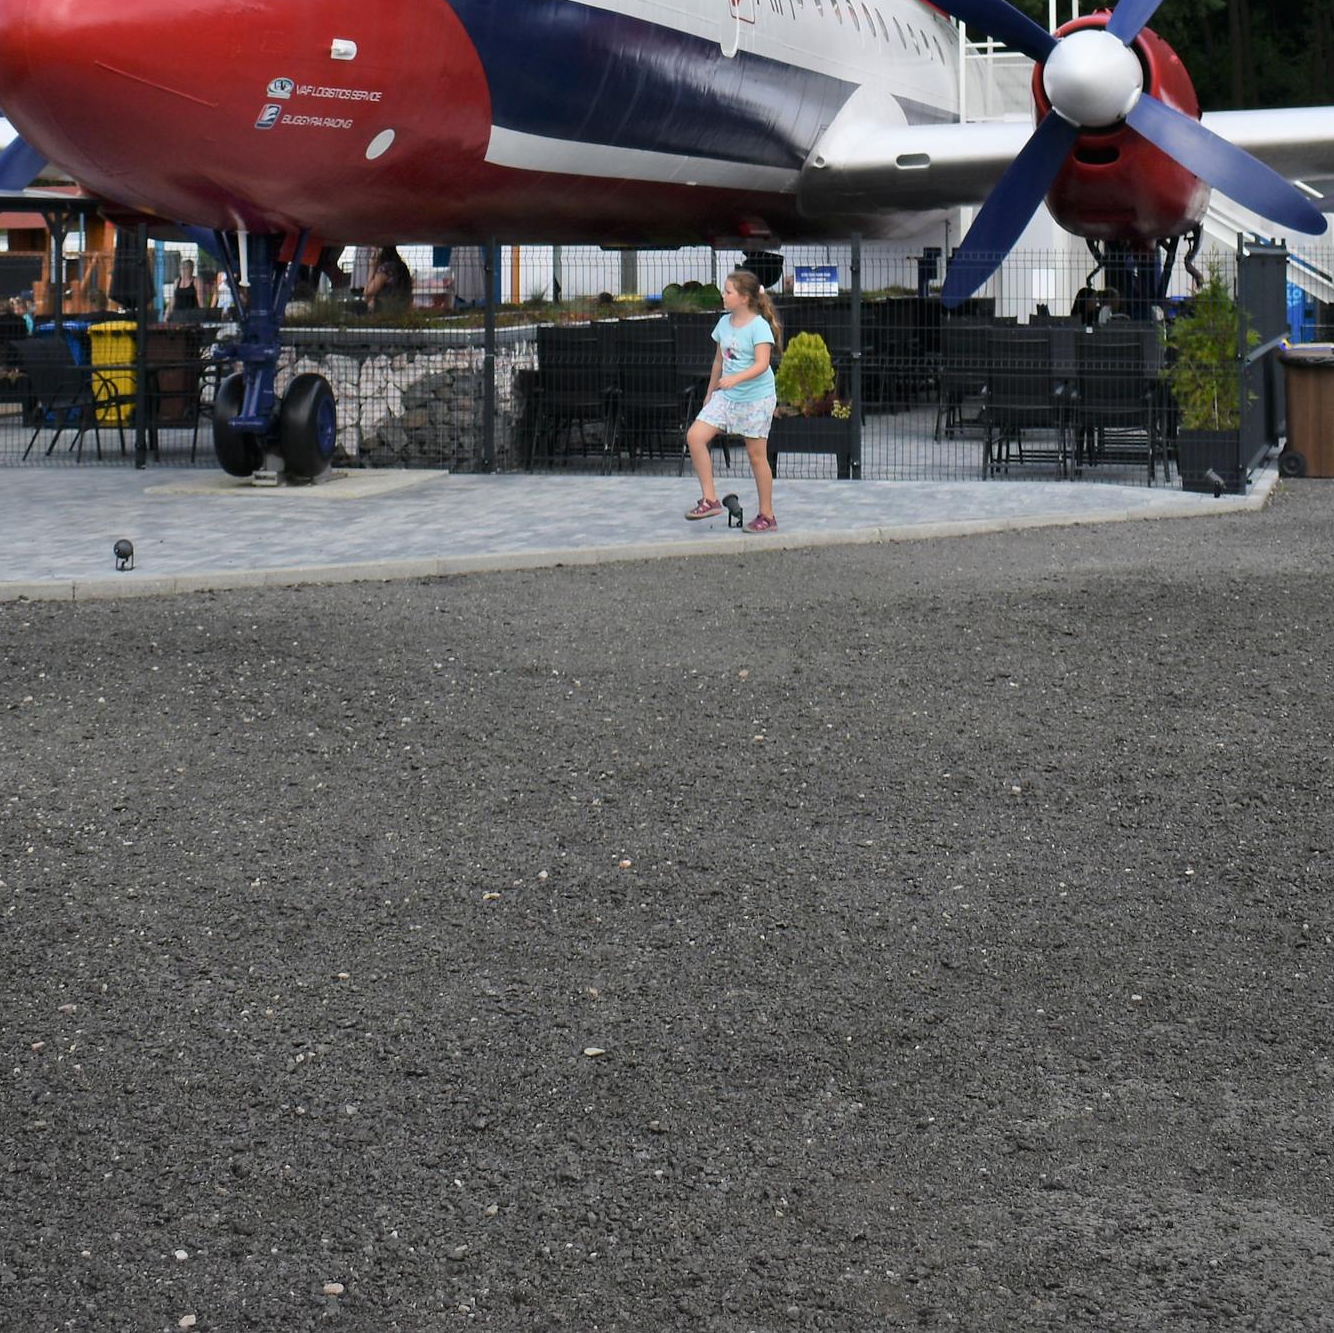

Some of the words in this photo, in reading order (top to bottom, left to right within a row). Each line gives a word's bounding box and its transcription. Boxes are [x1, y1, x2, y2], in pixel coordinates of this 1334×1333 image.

[311, 86, 351, 100] LOGISTICS
[350, 90, 383, 102] SERVICE
[281, 114, 322, 126] BUGGYRA
[321, 117, 354, 129] RACING
